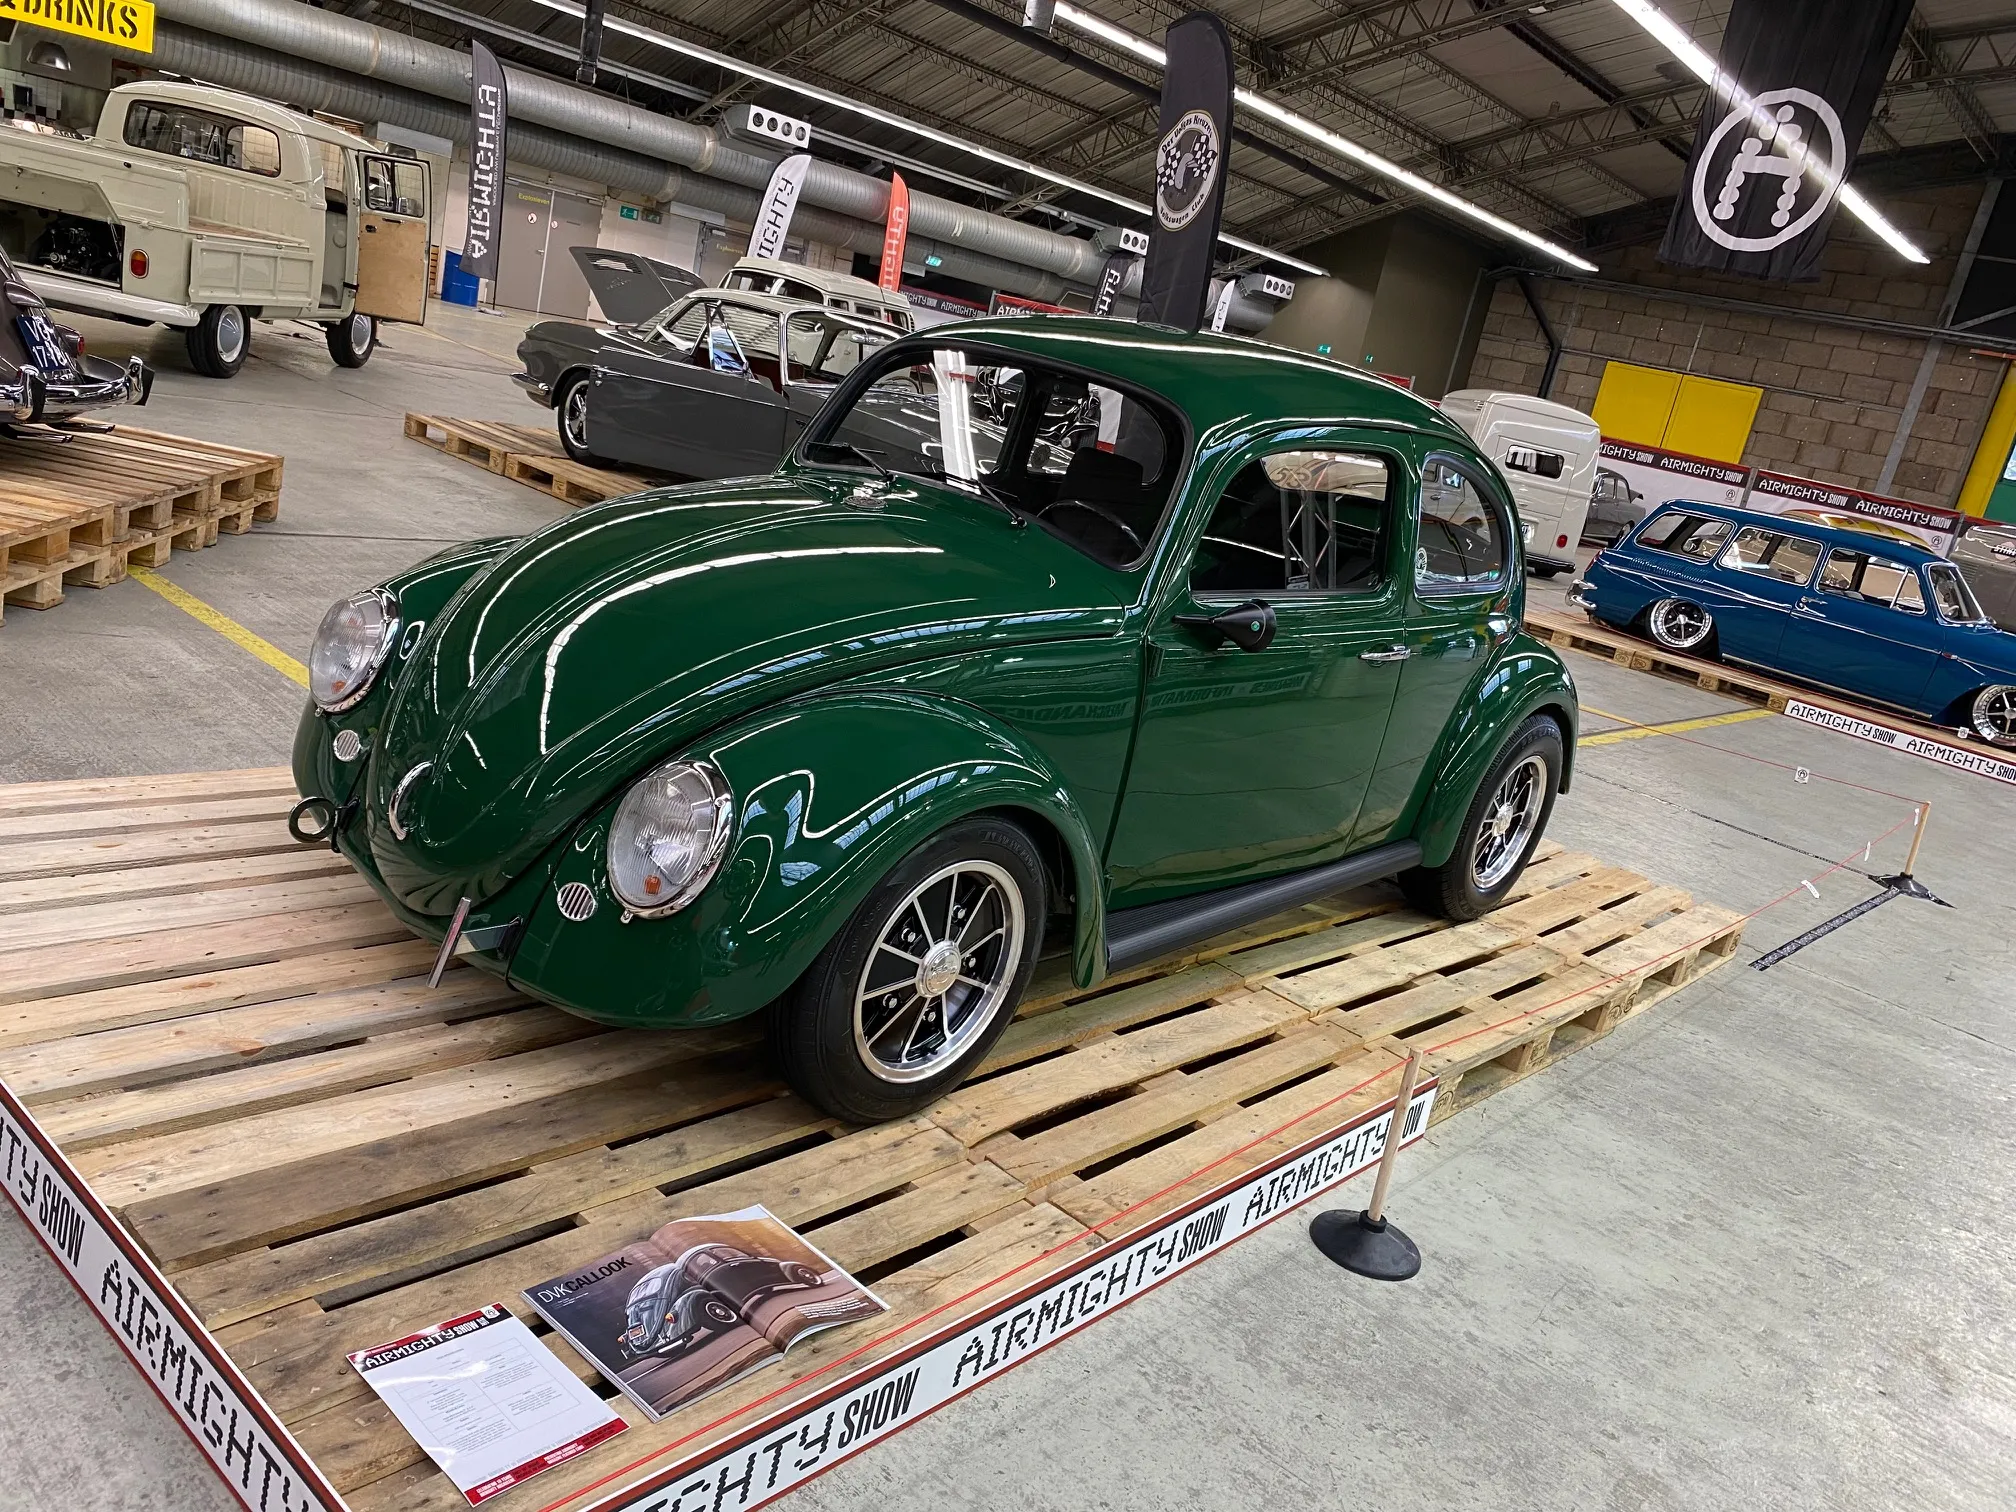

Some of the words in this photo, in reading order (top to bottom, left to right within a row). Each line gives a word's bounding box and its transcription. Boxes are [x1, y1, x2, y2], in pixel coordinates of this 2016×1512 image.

[1635, 450, 1655, 464] SHOW
[1660, 456, 1725, 480] AIRMIGHTY
[1723, 469, 1744, 484] SHOW
[1758, 479, 1829, 503] AIRMIGHTY
[1827, 493, 1849, 507] SHOW
[1855, 499, 1931, 525] AIRMIGHTY
[1930, 515, 1953, 530] SHOW
[1789, 703, 1873, 737] AIRMIGHTY
[1872, 727, 1898, 745] SHOW
[1906, 738, 1997, 774] AIRMIGHTY
[0, 1116, 39, 1207] TY
[38, 1173, 86, 1268] SHOW
[1242, 1117, 1392, 1227] AIRMIGHTY
[365, 1328, 456, 1368] AIRMIGHTY
[454, 1318, 480, 1336] SHOW
[837, 1366, 921, 1450] SHOW
[952, 1229, 1179, 1388] AIRMIGHTY
[1177, 1202, 1231, 1263] SHOW
